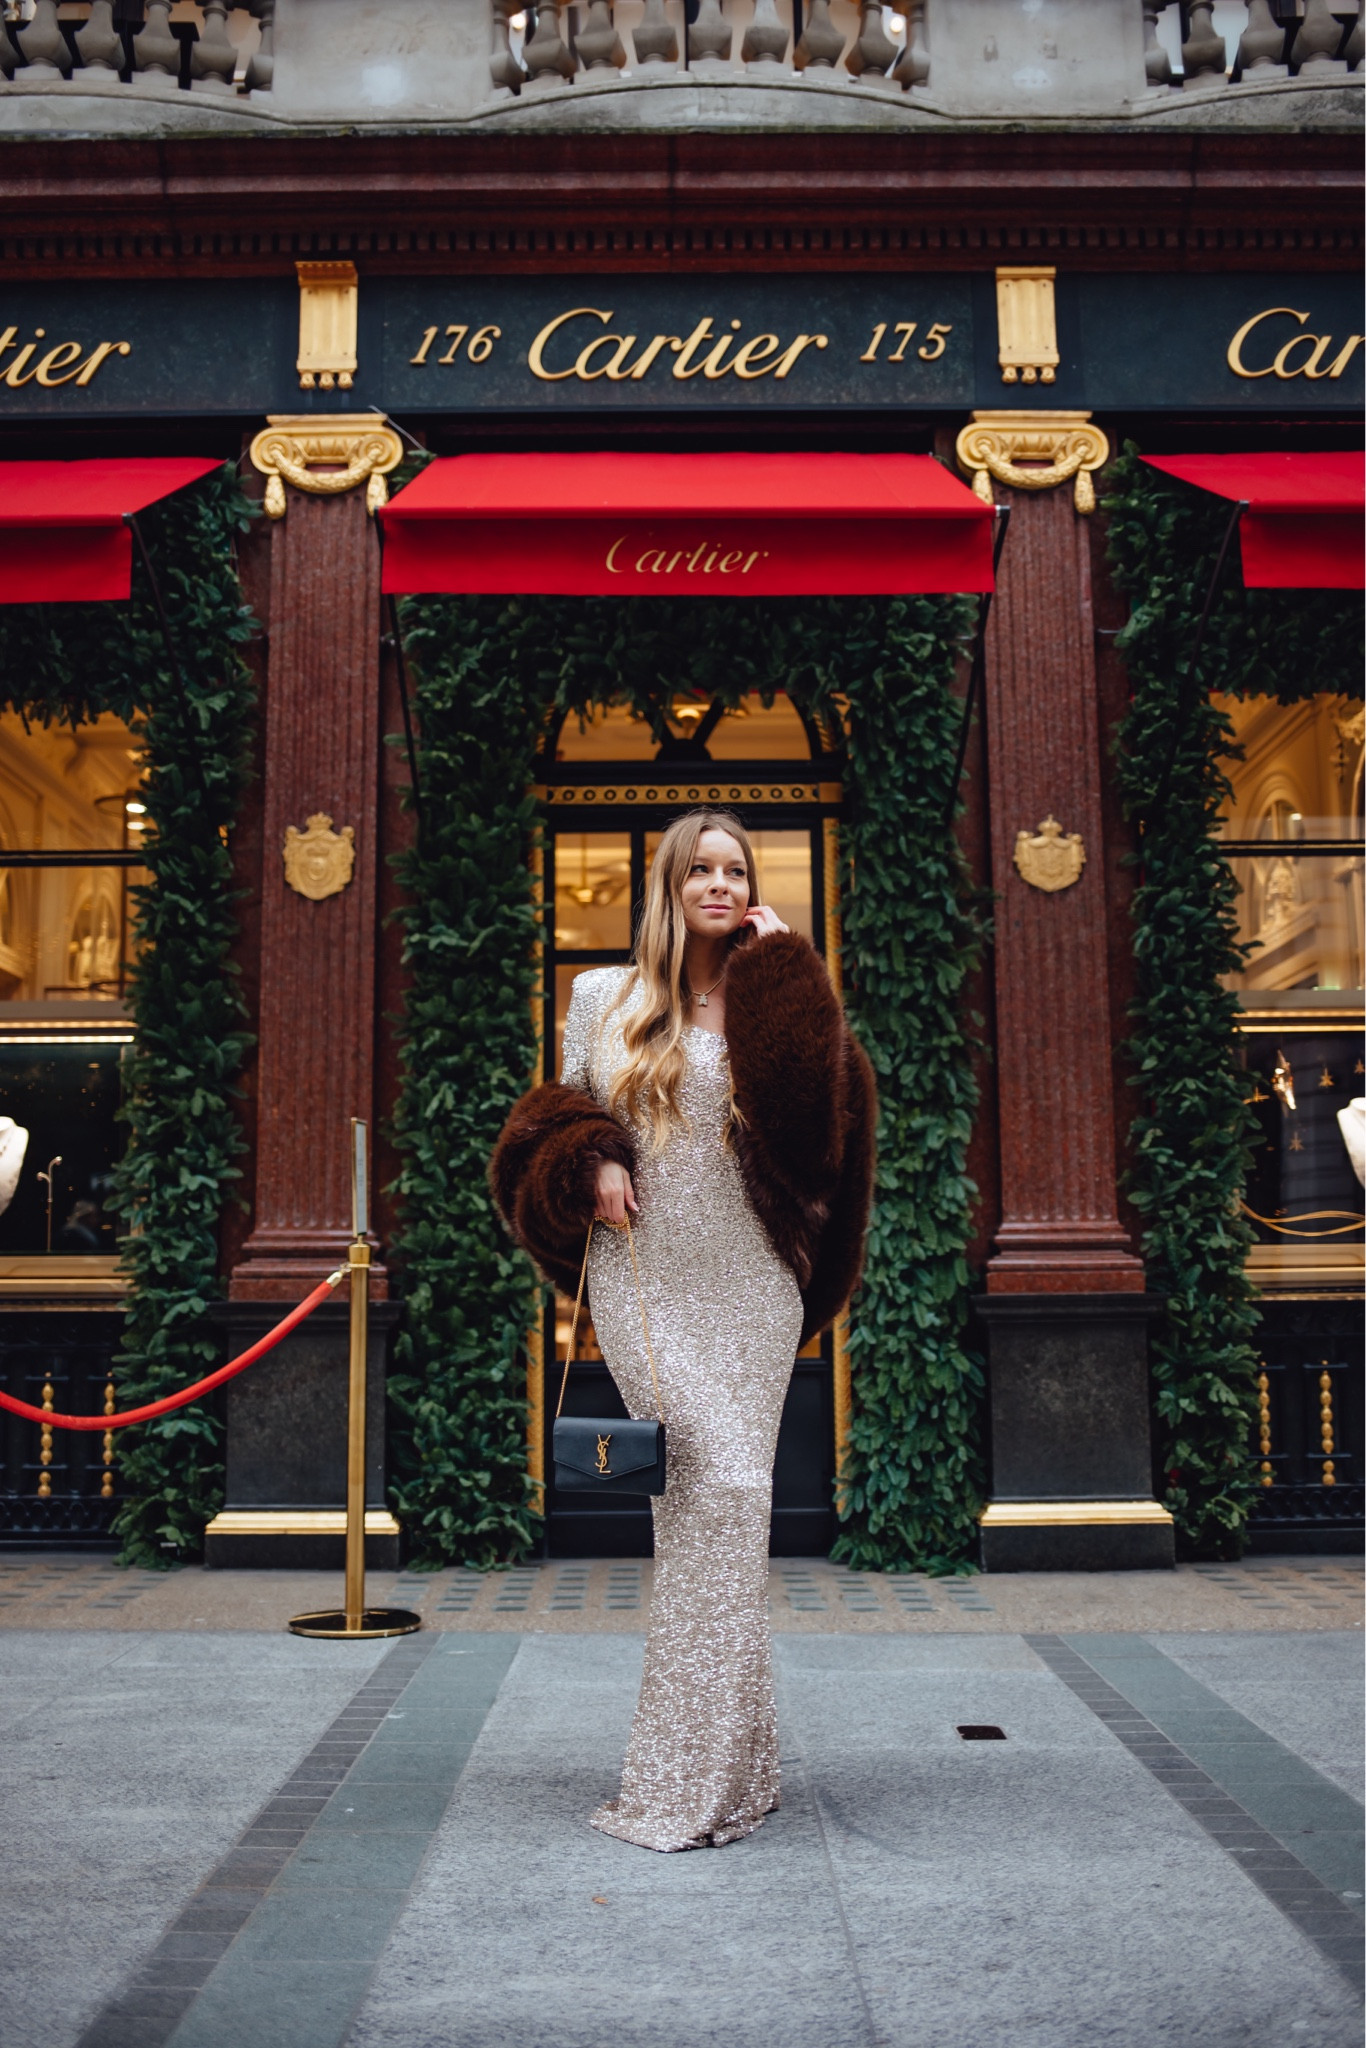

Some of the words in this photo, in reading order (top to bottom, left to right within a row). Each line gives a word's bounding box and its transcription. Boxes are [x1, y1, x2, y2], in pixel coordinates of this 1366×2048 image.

[411, 325, 501, 364] 176
[527, 308, 829, 380] Cartier
[860, 322, 952, 361] 175
[1227, 307, 1365, 379] Car
[605, 533, 769, 574] Cartier
[594, 1434, 612, 1474] YSL
